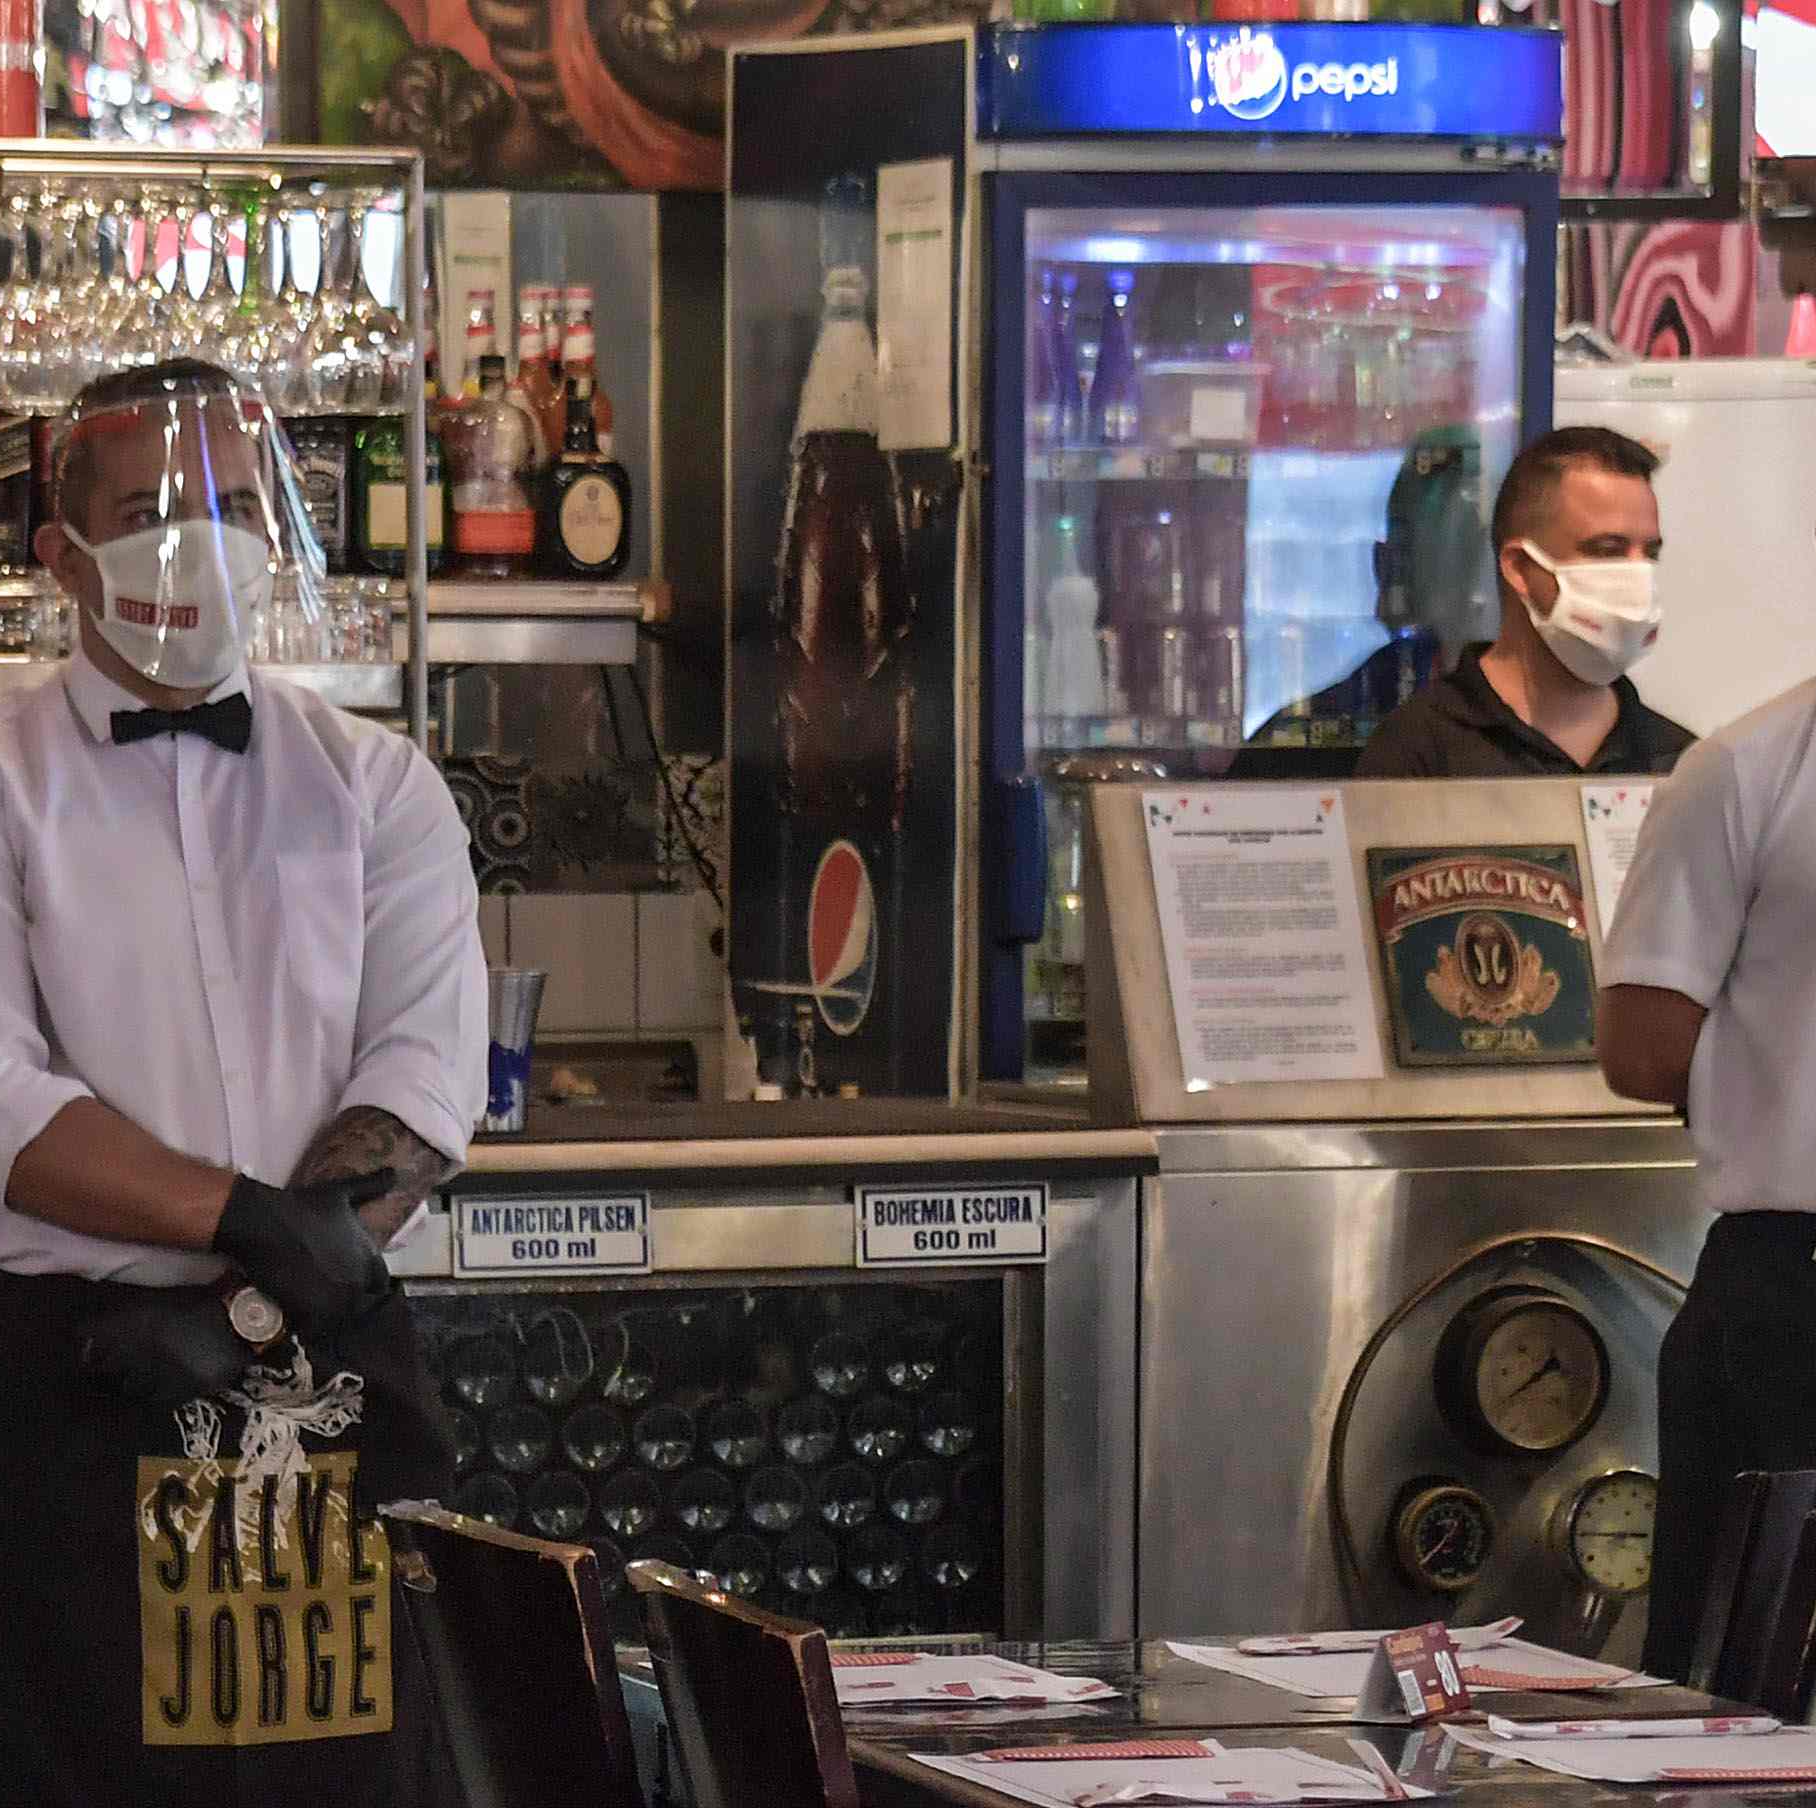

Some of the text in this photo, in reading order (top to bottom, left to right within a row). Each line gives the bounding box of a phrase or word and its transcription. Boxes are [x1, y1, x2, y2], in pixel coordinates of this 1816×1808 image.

[1291, 57, 1399, 102] pepsi
[1393, 867, 1572, 912] ANTARCTICA
[471, 1205, 637, 1235] ANTARCTICA PILSEN
[873, 1196, 1033, 1227] BOHEMIA ESCURA
[511, 1237, 597, 1260] 600 ml
[912, 1228, 997, 1251] 600 ml
[153, 1465, 377, 1595] SALVE
[158, 1595, 377, 1729] JORGE
